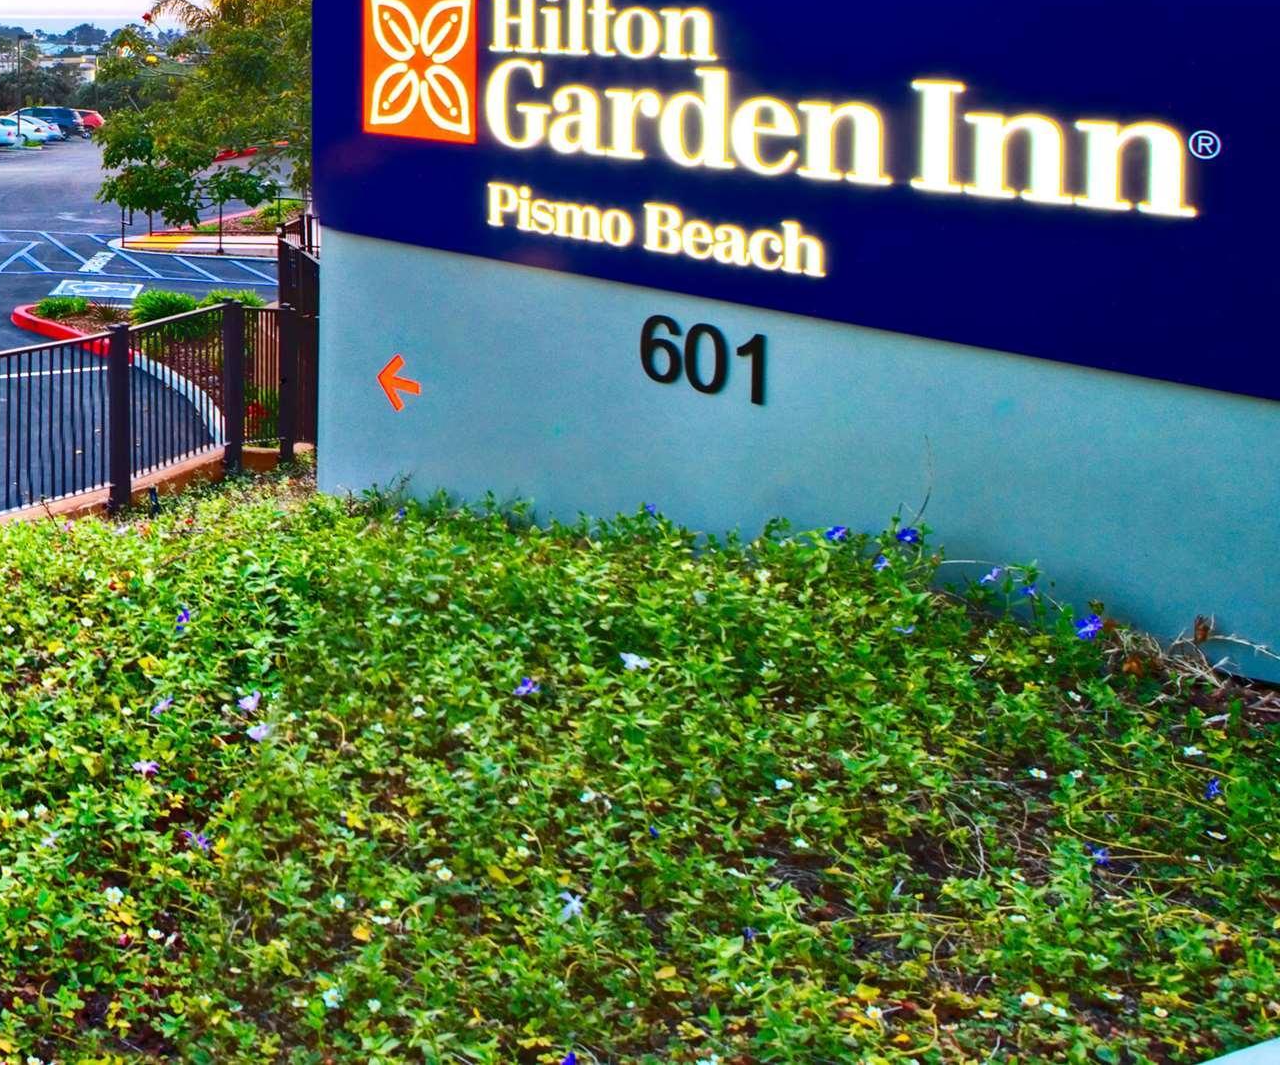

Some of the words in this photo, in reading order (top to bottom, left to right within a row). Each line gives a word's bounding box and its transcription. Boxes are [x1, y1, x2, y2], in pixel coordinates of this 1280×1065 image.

[485, 58, 892, 185] Garden
[487, 182, 635, 247] Pismo
[643, 202, 825, 277] Beach
[640, 315, 767, 405] 601
